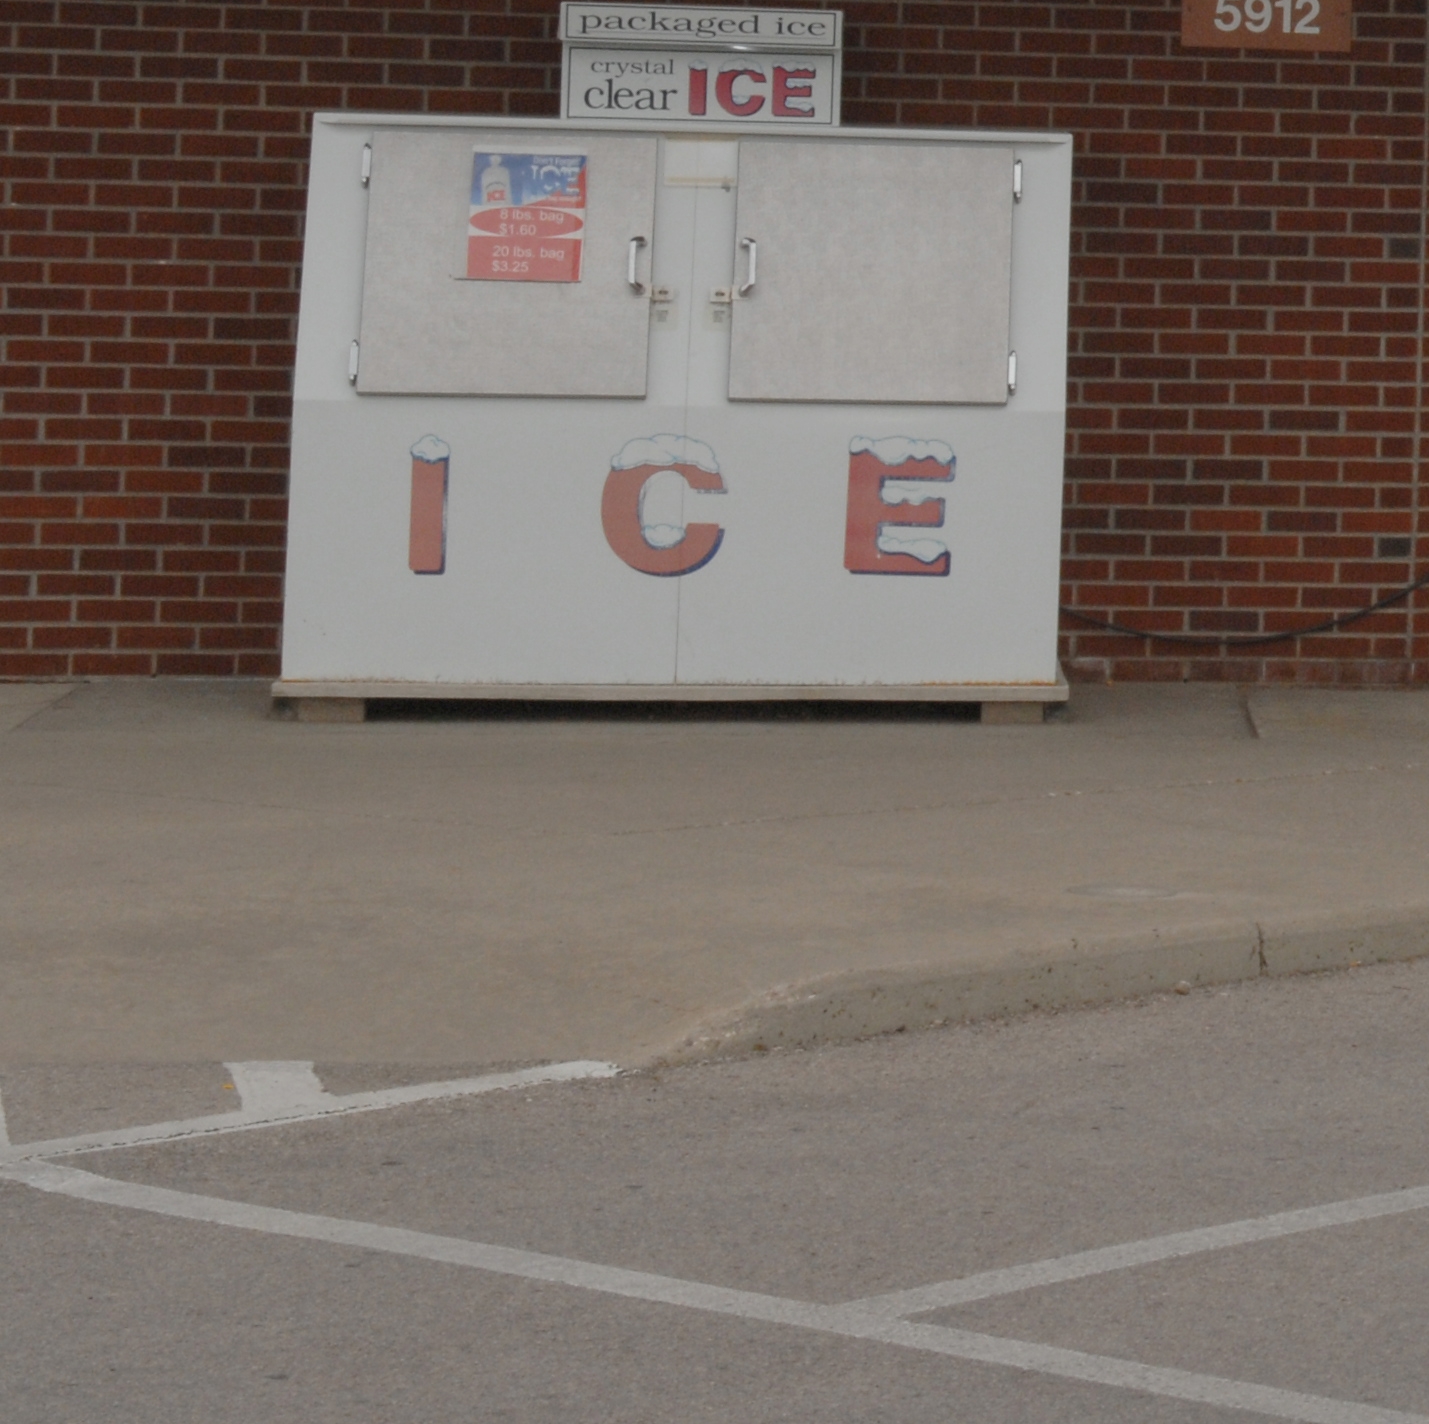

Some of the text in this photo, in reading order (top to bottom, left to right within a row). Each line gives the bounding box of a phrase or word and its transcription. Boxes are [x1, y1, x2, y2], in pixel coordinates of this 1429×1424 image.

[579, 12, 826, 38] packaged ice
[590, 59, 674, 77] crystal
[584, 58, 816, 117] clear ICE
[500, 209, 508, 219] 8
[540, 211, 564, 224] bag
[499, 223, 536, 236] $1.60
[493, 245, 510, 257] 20
[540, 248, 565, 260] bag
[492, 260, 529, 273] $3.25
[408, 434, 957, 578] ICE
